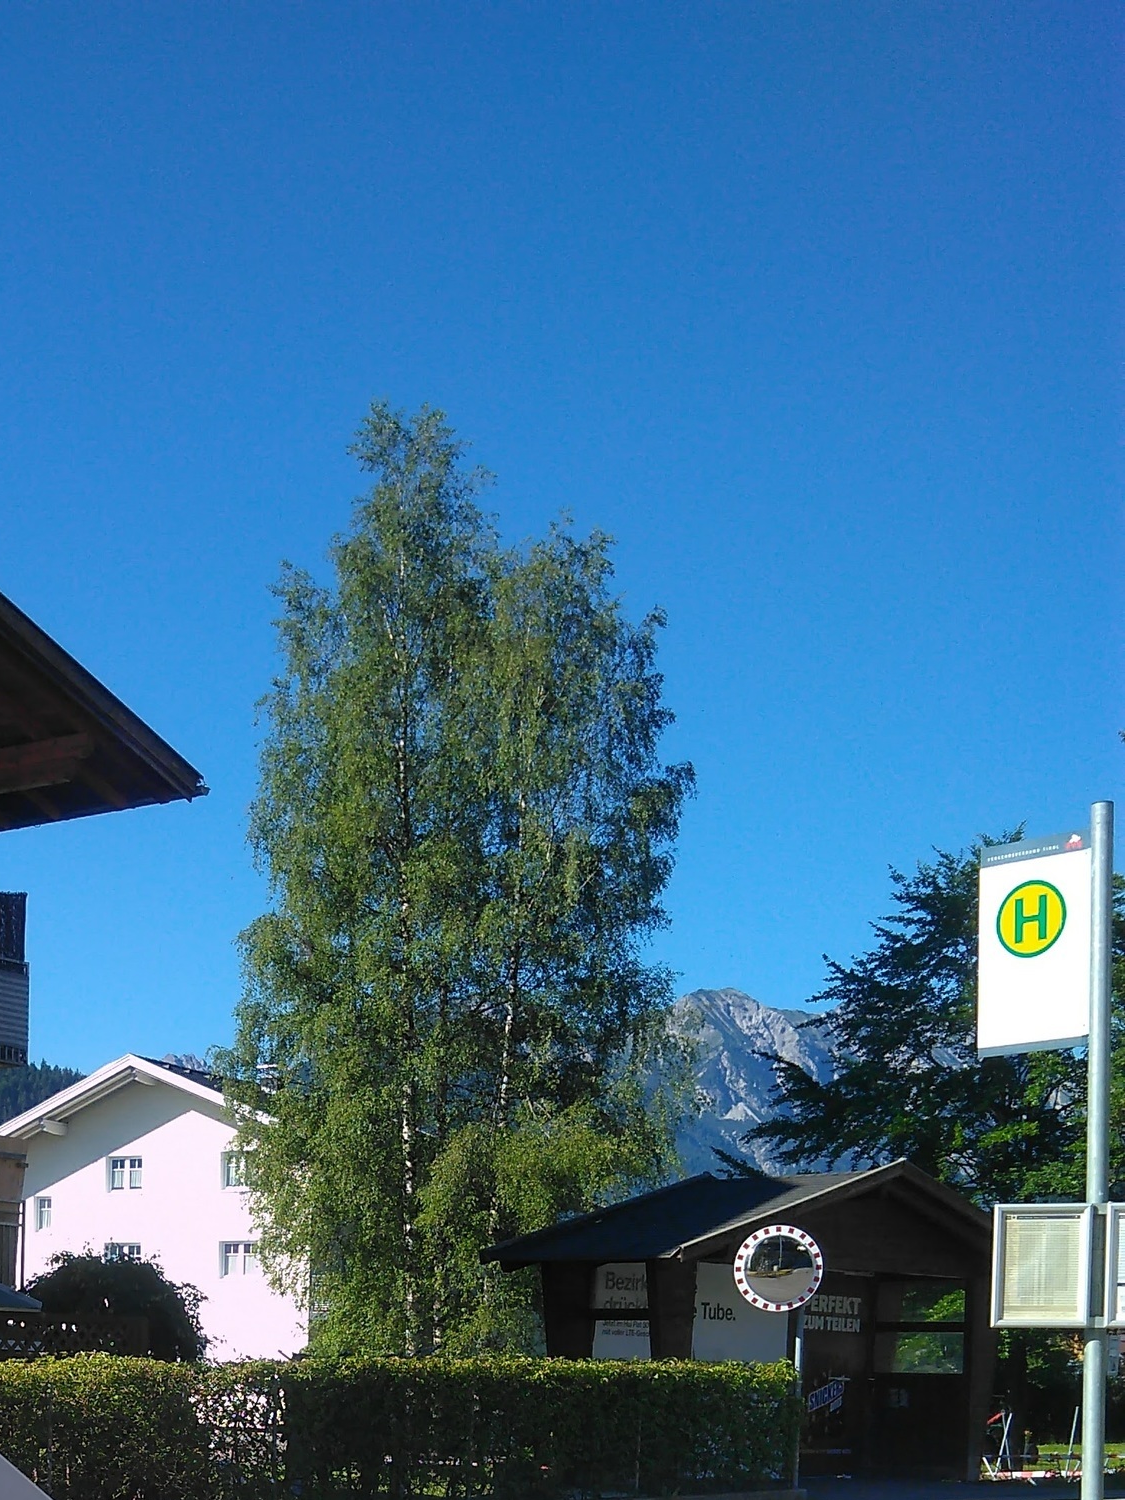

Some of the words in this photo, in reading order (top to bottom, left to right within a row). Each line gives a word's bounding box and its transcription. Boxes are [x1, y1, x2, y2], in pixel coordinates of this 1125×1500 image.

[1015, 893, 1047, 944] H
[701, 1302, 736, 1321] Tube.
[803, 1294, 861, 1315] PERFEKT
[803, 1315, 824, 1330] ZUM
[826, 1317, 861, 1333] TEILEN
